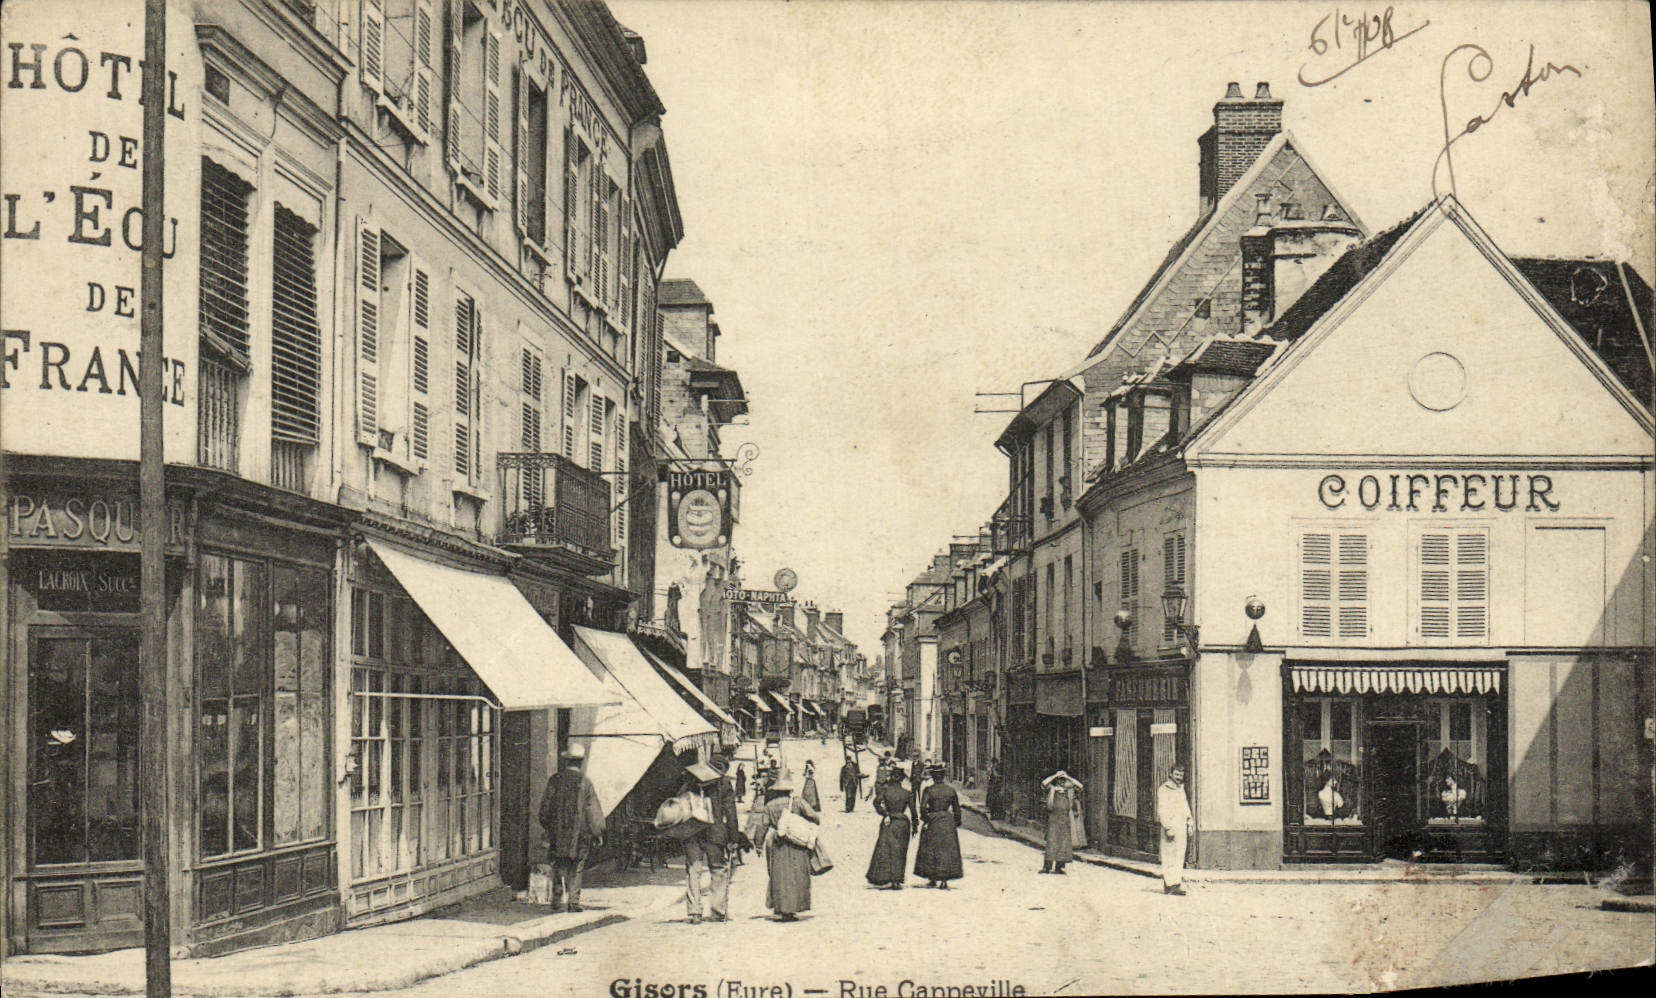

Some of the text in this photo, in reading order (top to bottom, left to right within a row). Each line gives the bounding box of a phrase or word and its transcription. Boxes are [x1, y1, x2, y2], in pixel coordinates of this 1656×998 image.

[88, 130, 138, 170] DE
[86, 282, 135, 319] DE
[1318, 474, 1560, 512] COIFFEUR
[11, 495, 183, 545] PASQUR
